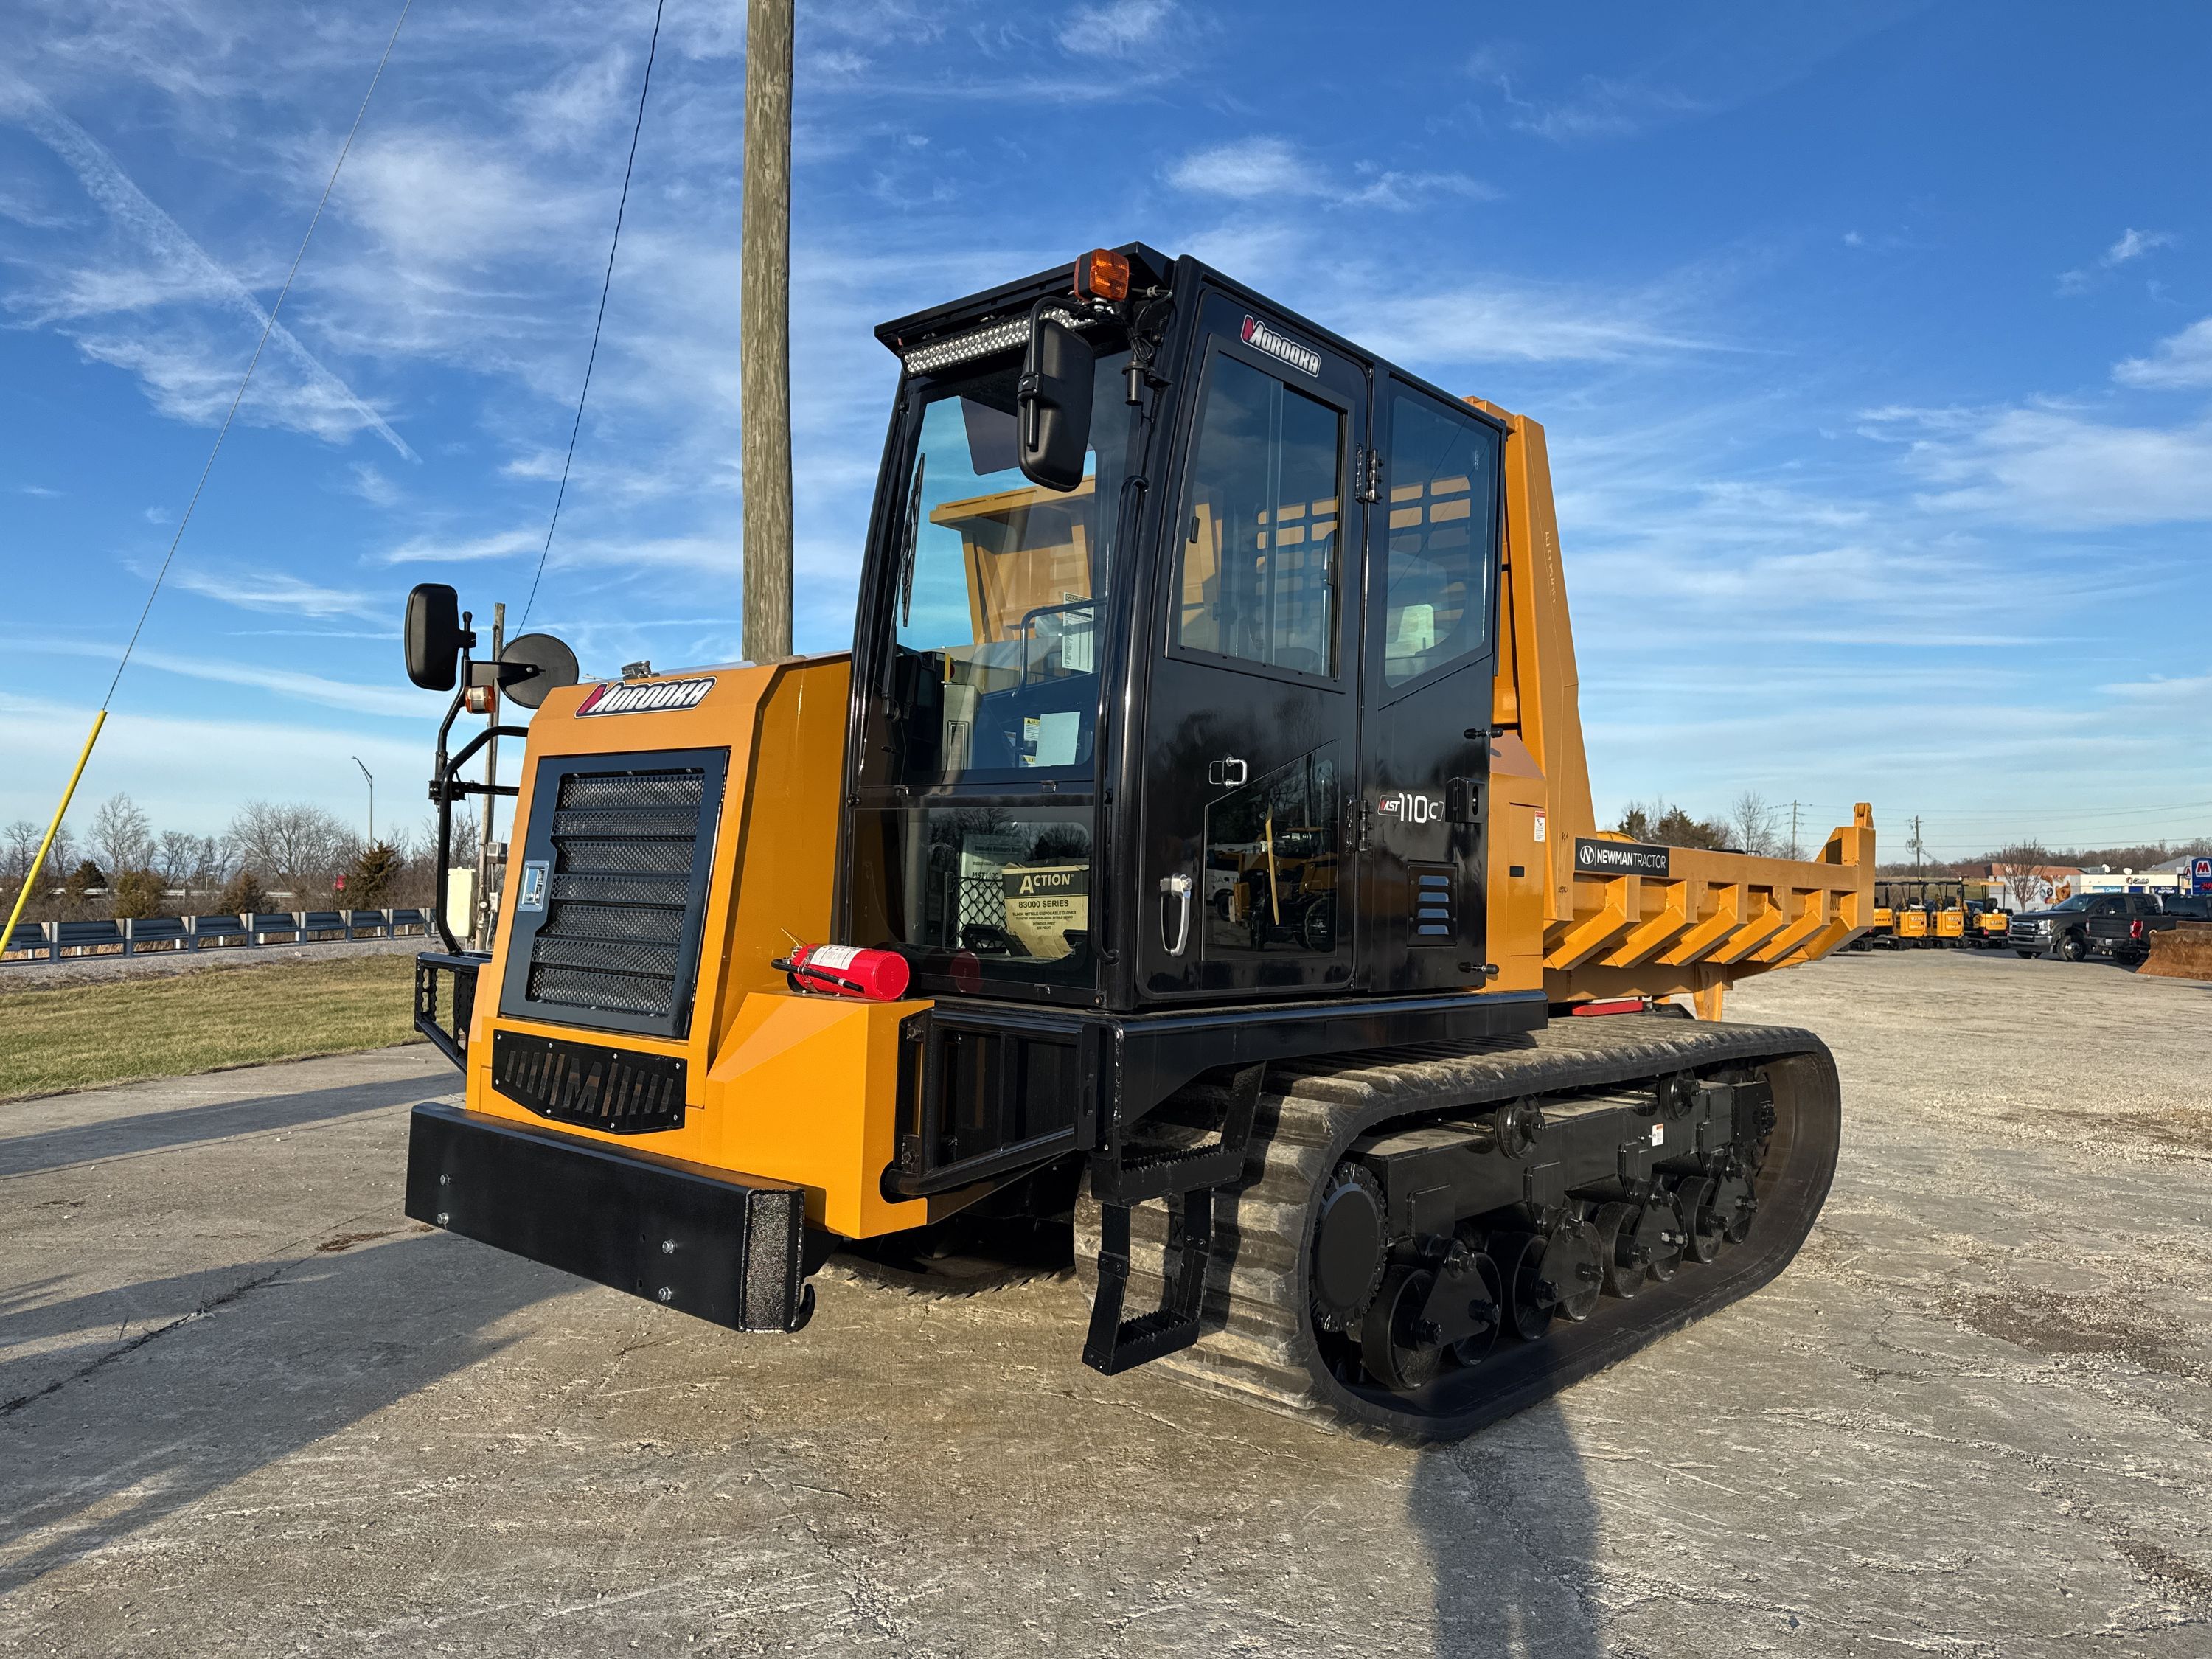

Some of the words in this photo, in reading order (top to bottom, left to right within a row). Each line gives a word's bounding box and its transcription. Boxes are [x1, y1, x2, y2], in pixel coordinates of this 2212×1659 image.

[577, 681, 713, 714] MOROOKA
[1019, 873, 1071, 894] ACTION
[1018, 900, 1041, 908] 83000
[1042, 900, 1069, 908] SERIES
